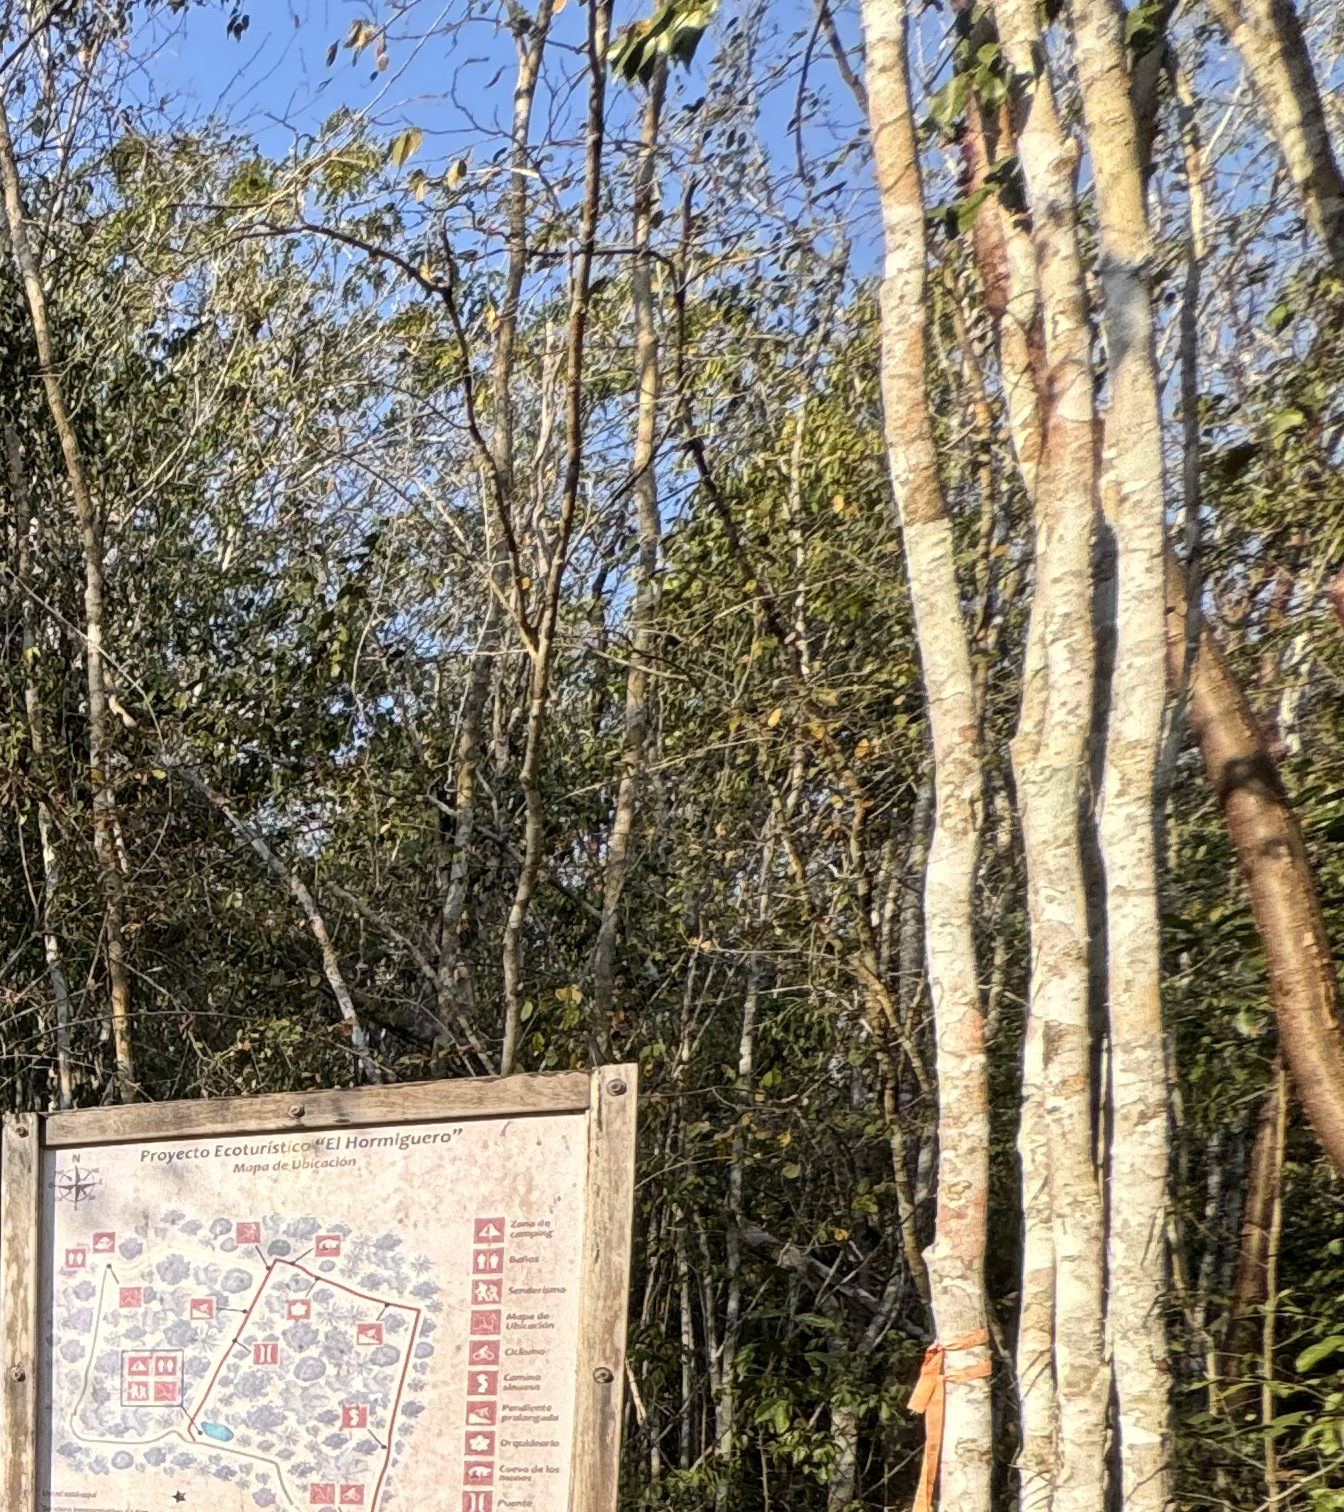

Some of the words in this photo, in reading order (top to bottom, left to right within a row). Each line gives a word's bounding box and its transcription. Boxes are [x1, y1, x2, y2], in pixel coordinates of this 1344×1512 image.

[140, 1146, 210, 1165] Proyecto
[214, 1140, 311, 1158] Ecoturístico
[232, 1161, 270, 1176] Mapa
[273, 1160, 289, 1172] de
[291, 1156, 357, 1171] Ubicación
